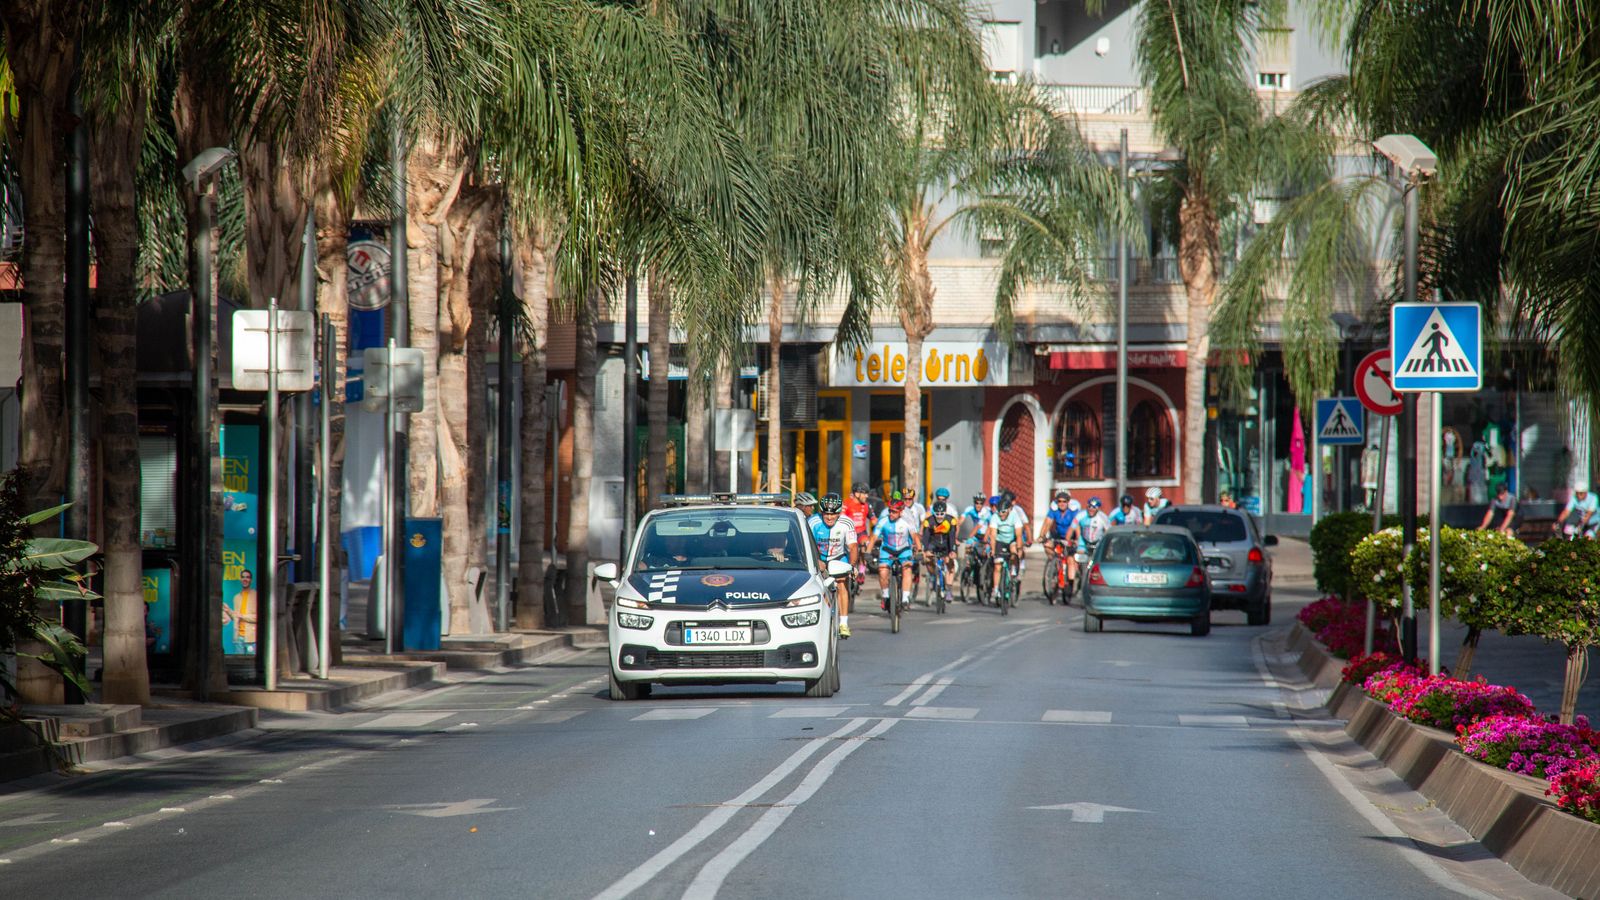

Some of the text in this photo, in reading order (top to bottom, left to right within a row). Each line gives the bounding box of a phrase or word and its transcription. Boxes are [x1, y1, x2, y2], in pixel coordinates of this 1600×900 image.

[855, 344, 989, 383] teleorno
[725, 591, 771, 600] POLICIA
[695, 630, 745, 641] 1340 LDX
